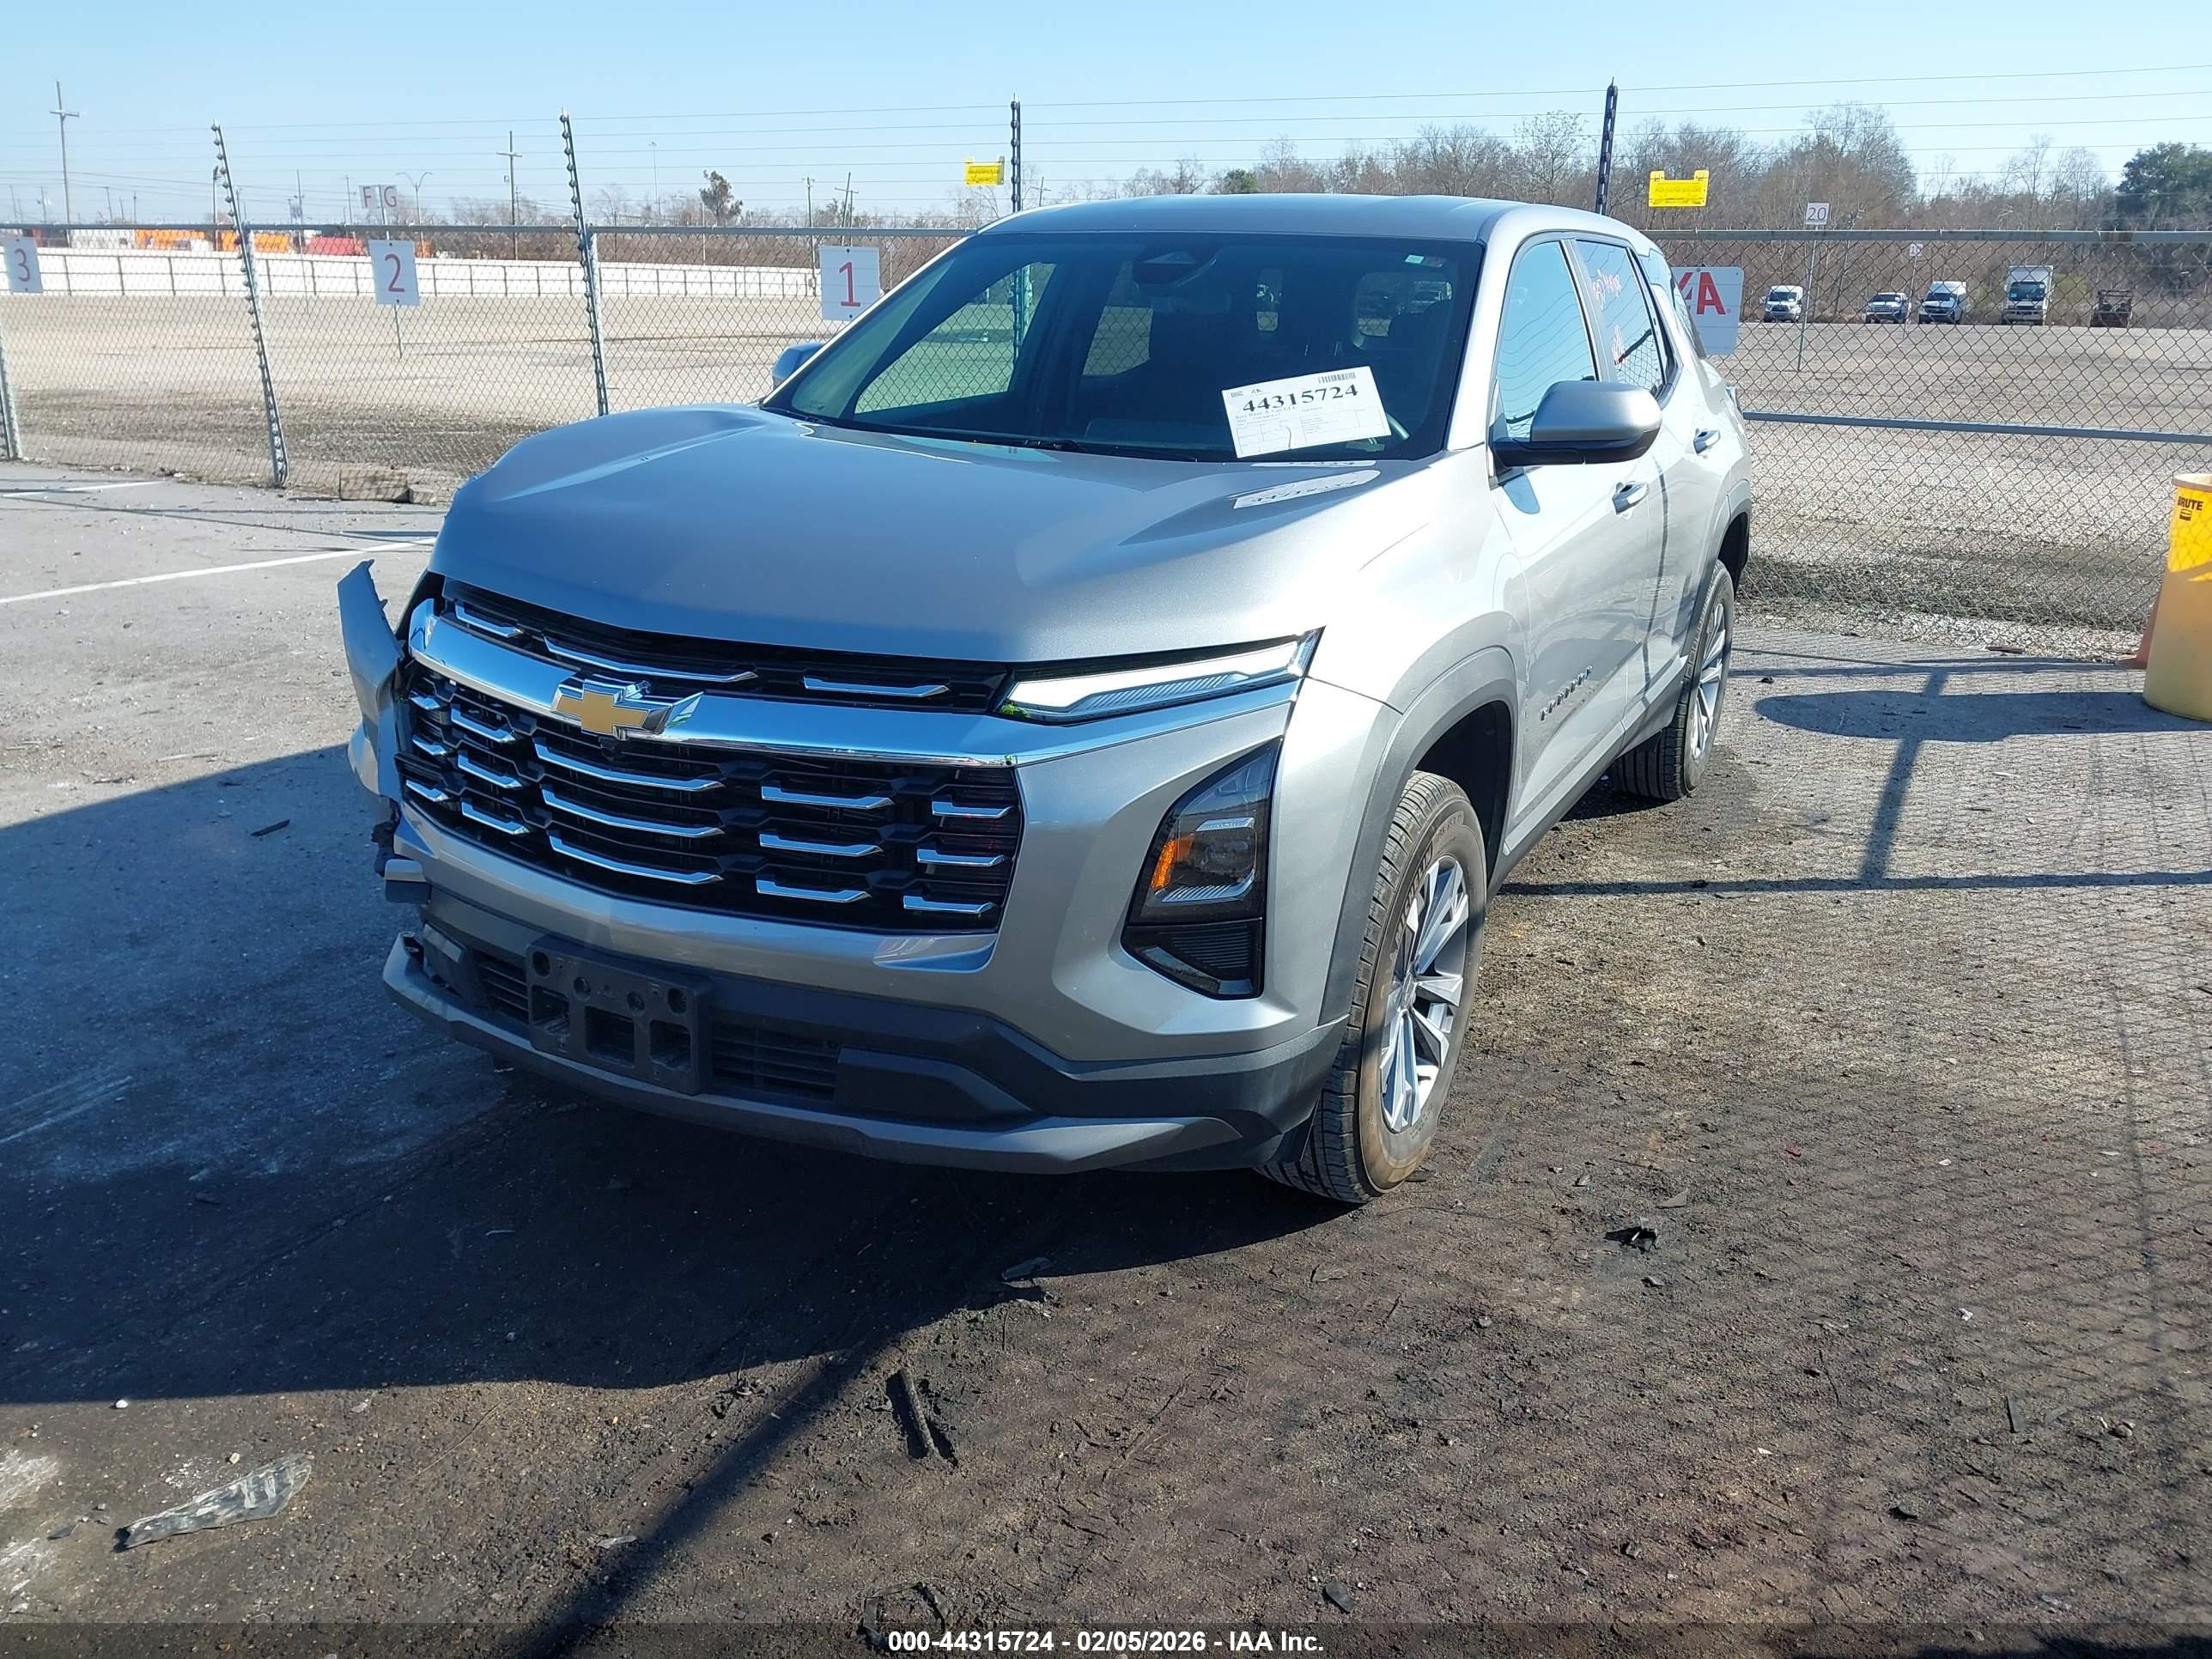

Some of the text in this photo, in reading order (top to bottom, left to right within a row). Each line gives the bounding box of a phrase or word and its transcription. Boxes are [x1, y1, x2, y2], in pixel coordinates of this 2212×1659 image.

[362, 185, 397, 207] F G
[1807, 207, 1827, 221] 20
[15, 248, 30, 282] 3
[385, 253, 405, 293] 2
[839, 261, 860, 307] 1
[1243, 384, 1358, 412] 44315724
[2178, 495, 2203, 511] BRUTE
[1395, 840, 1433, 945] MICHELIN
